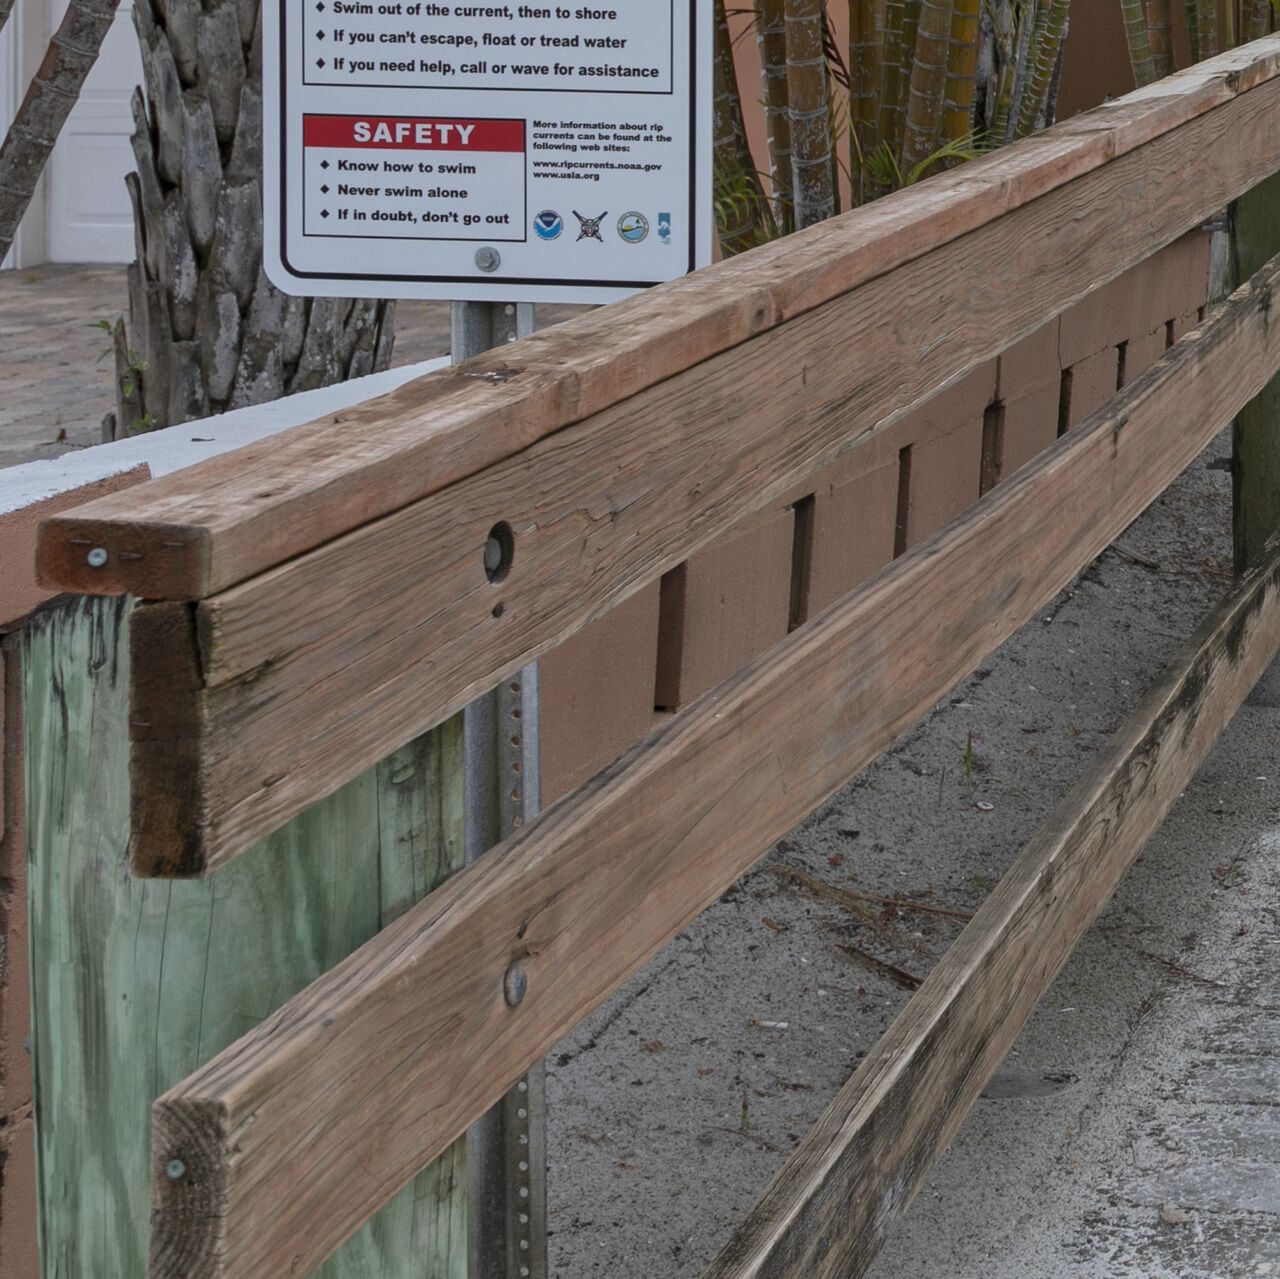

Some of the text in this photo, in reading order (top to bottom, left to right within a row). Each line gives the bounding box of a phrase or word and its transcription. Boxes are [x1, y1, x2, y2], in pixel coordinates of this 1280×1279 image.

[333, 1, 617, 20] Swim out of the current, then to shore
[334, 30, 627, 48] If you can't escape, float or tread water
[334, 58, 659, 78] If you need help, call or wave for assistance
[353, 122, 475, 144] SAFETY
[533, 120, 557, 128] More
[561, 121, 616, 130] information
[650, 124, 663, 132] rip
[533, 142, 577, 151] following
[604, 144, 630, 152] sites:
[338, 160, 476, 174] Know how to swim
[533, 161, 662, 172] www.ripcurrents.noaa.gov
[533, 172, 600, 181] www.usla.org
[338, 184, 468, 198] Never swim alone
[338, 209, 509, 225] If in doubt, don't go out
